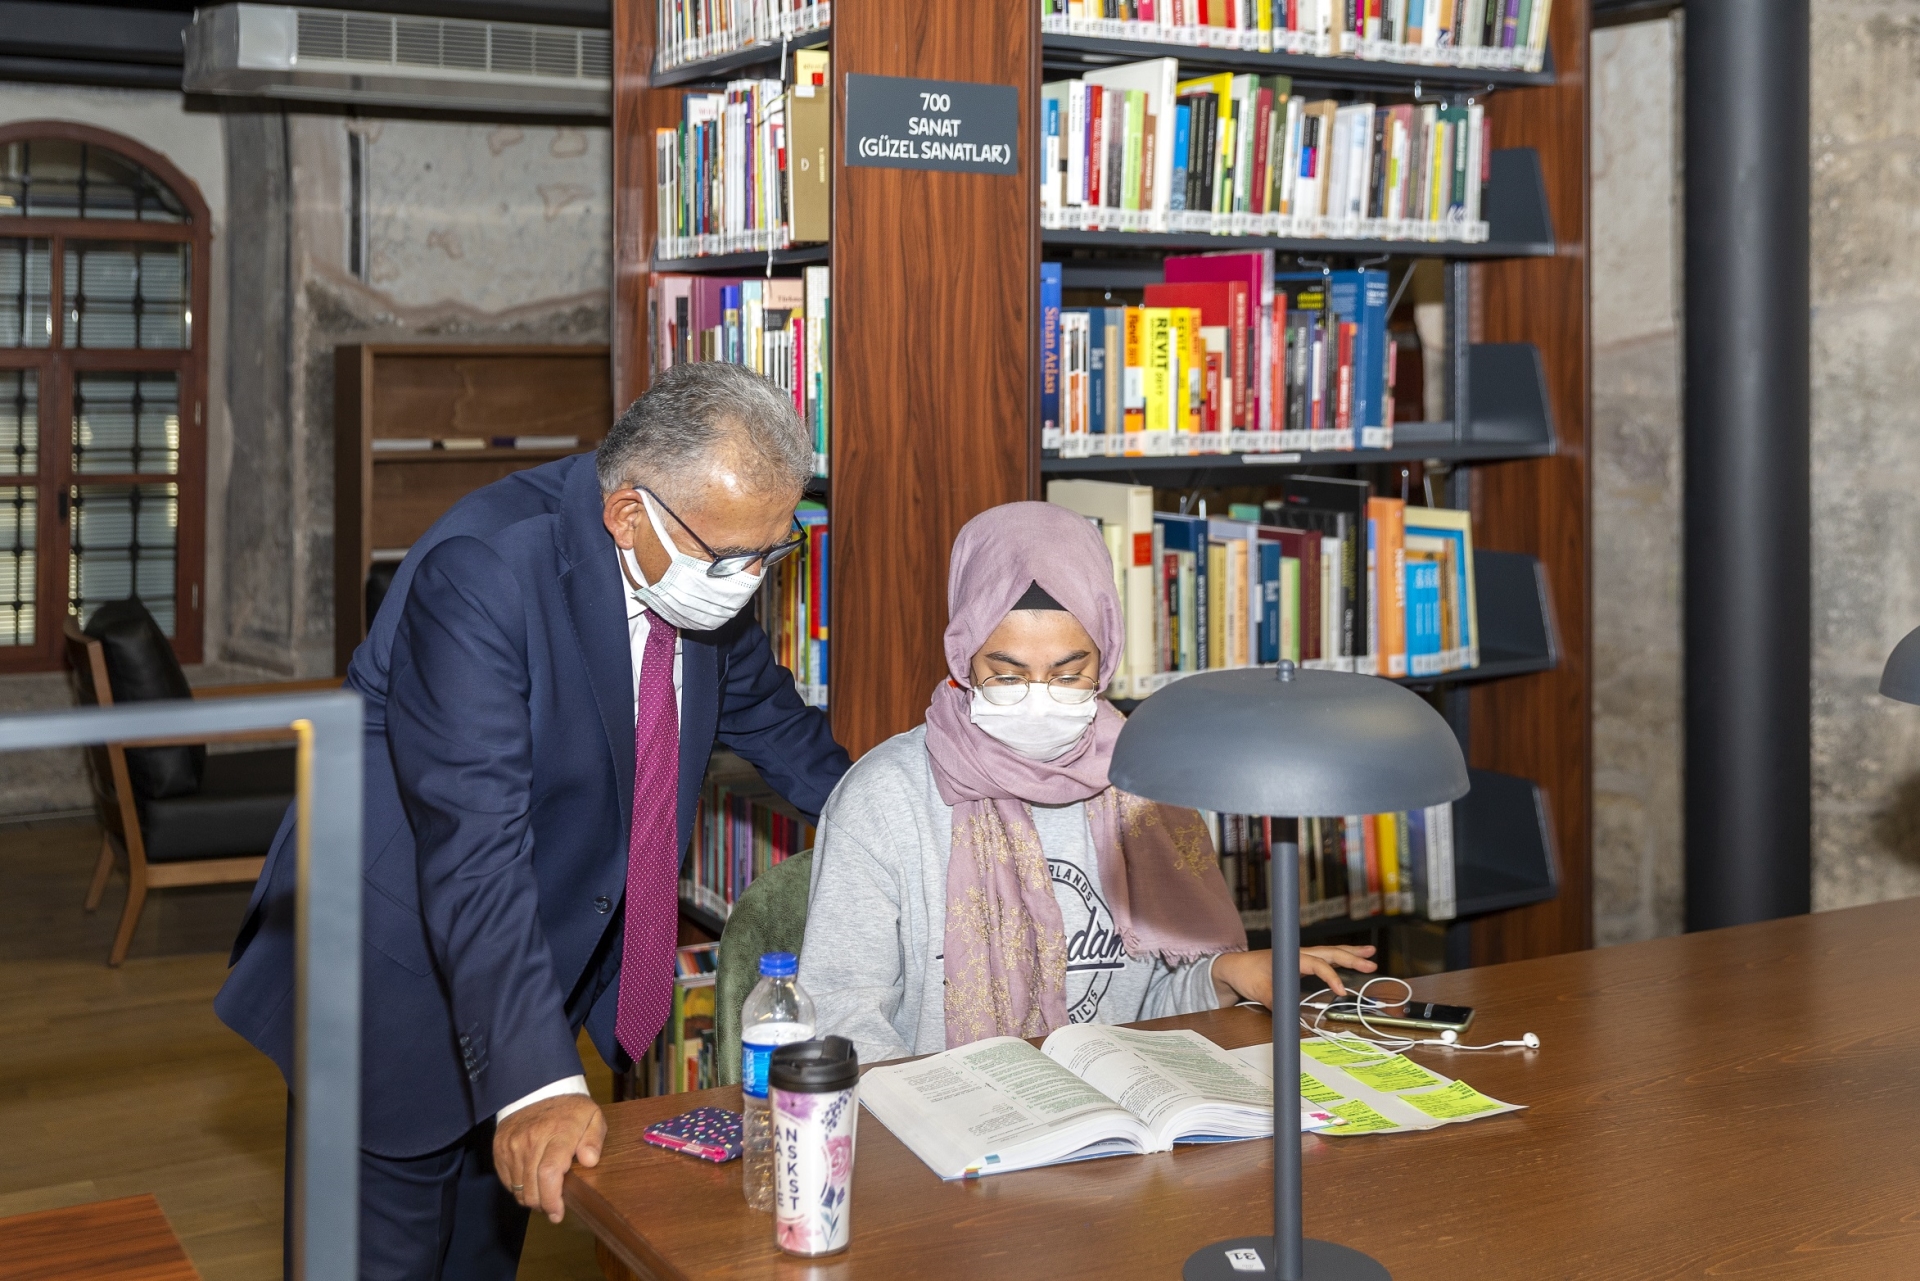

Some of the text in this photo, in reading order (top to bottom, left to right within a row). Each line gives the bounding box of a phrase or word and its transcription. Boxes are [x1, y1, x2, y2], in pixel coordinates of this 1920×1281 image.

[920, 92, 951, 112] 700
[908, 117, 962, 137] SANAT
[858, 135, 1011, 165] (GÜZEL SANATLAR)
[1044, 306, 1059, 394] Sinan Atlası
[1156, 317, 1168, 371] REVIT
[1048, 864, 1093, 902] RLANDS
[1067, 906, 1127, 961] dam
[1068, 989, 1098, 1024] RICTS
